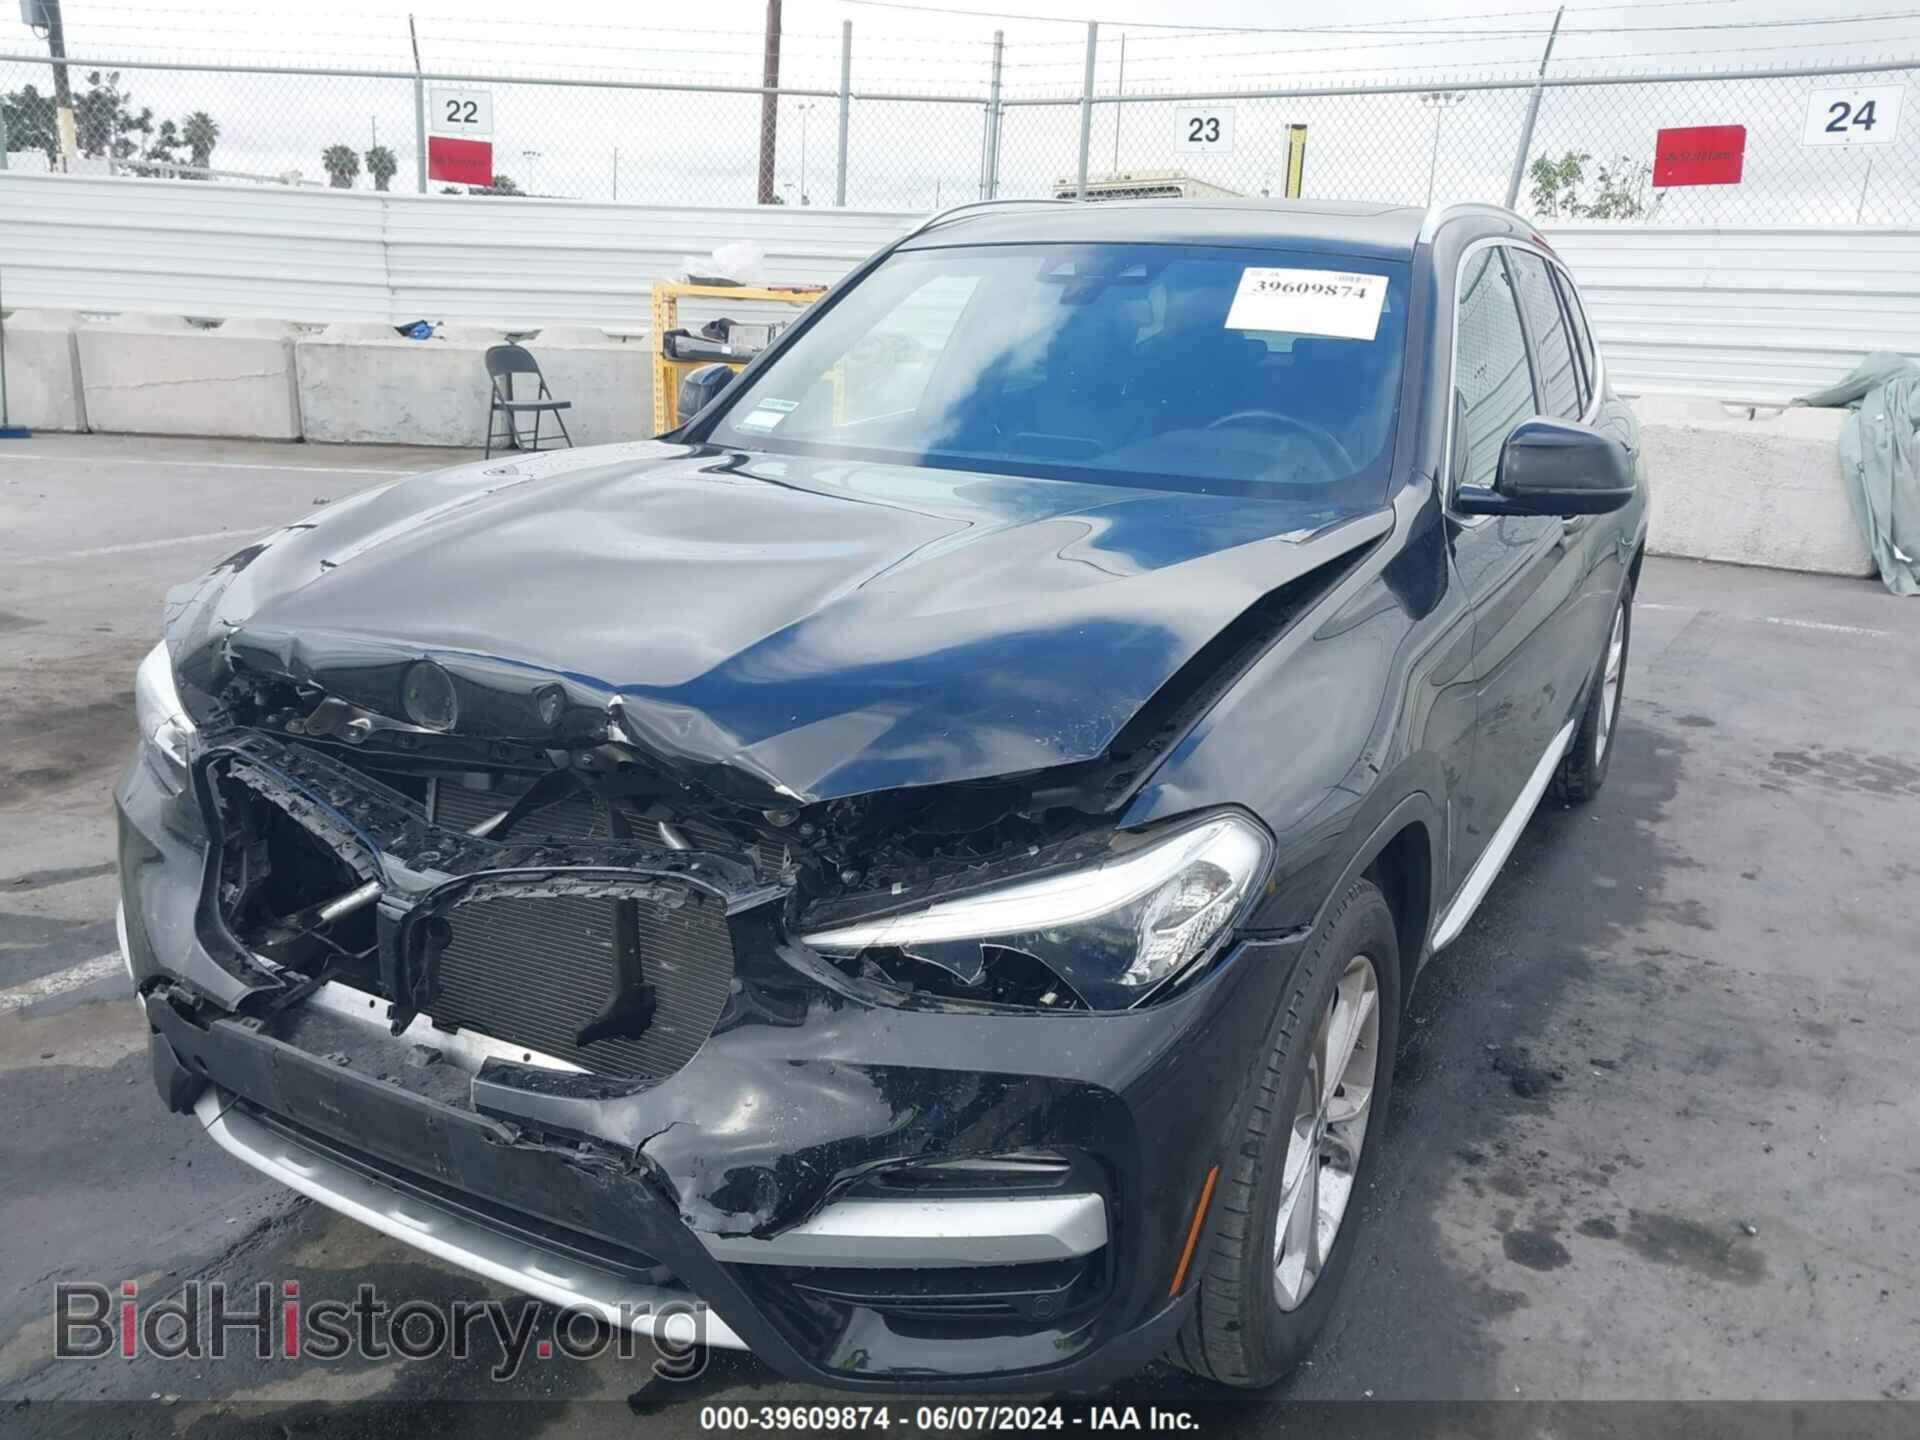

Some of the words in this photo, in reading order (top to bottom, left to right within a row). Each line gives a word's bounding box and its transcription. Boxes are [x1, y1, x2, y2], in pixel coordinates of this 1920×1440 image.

[446, 99, 479, 124] 22
[1825, 100, 1877, 133] 24
[1188, 117, 1220, 143] 23
[1252, 280, 1367, 299] 39609874
